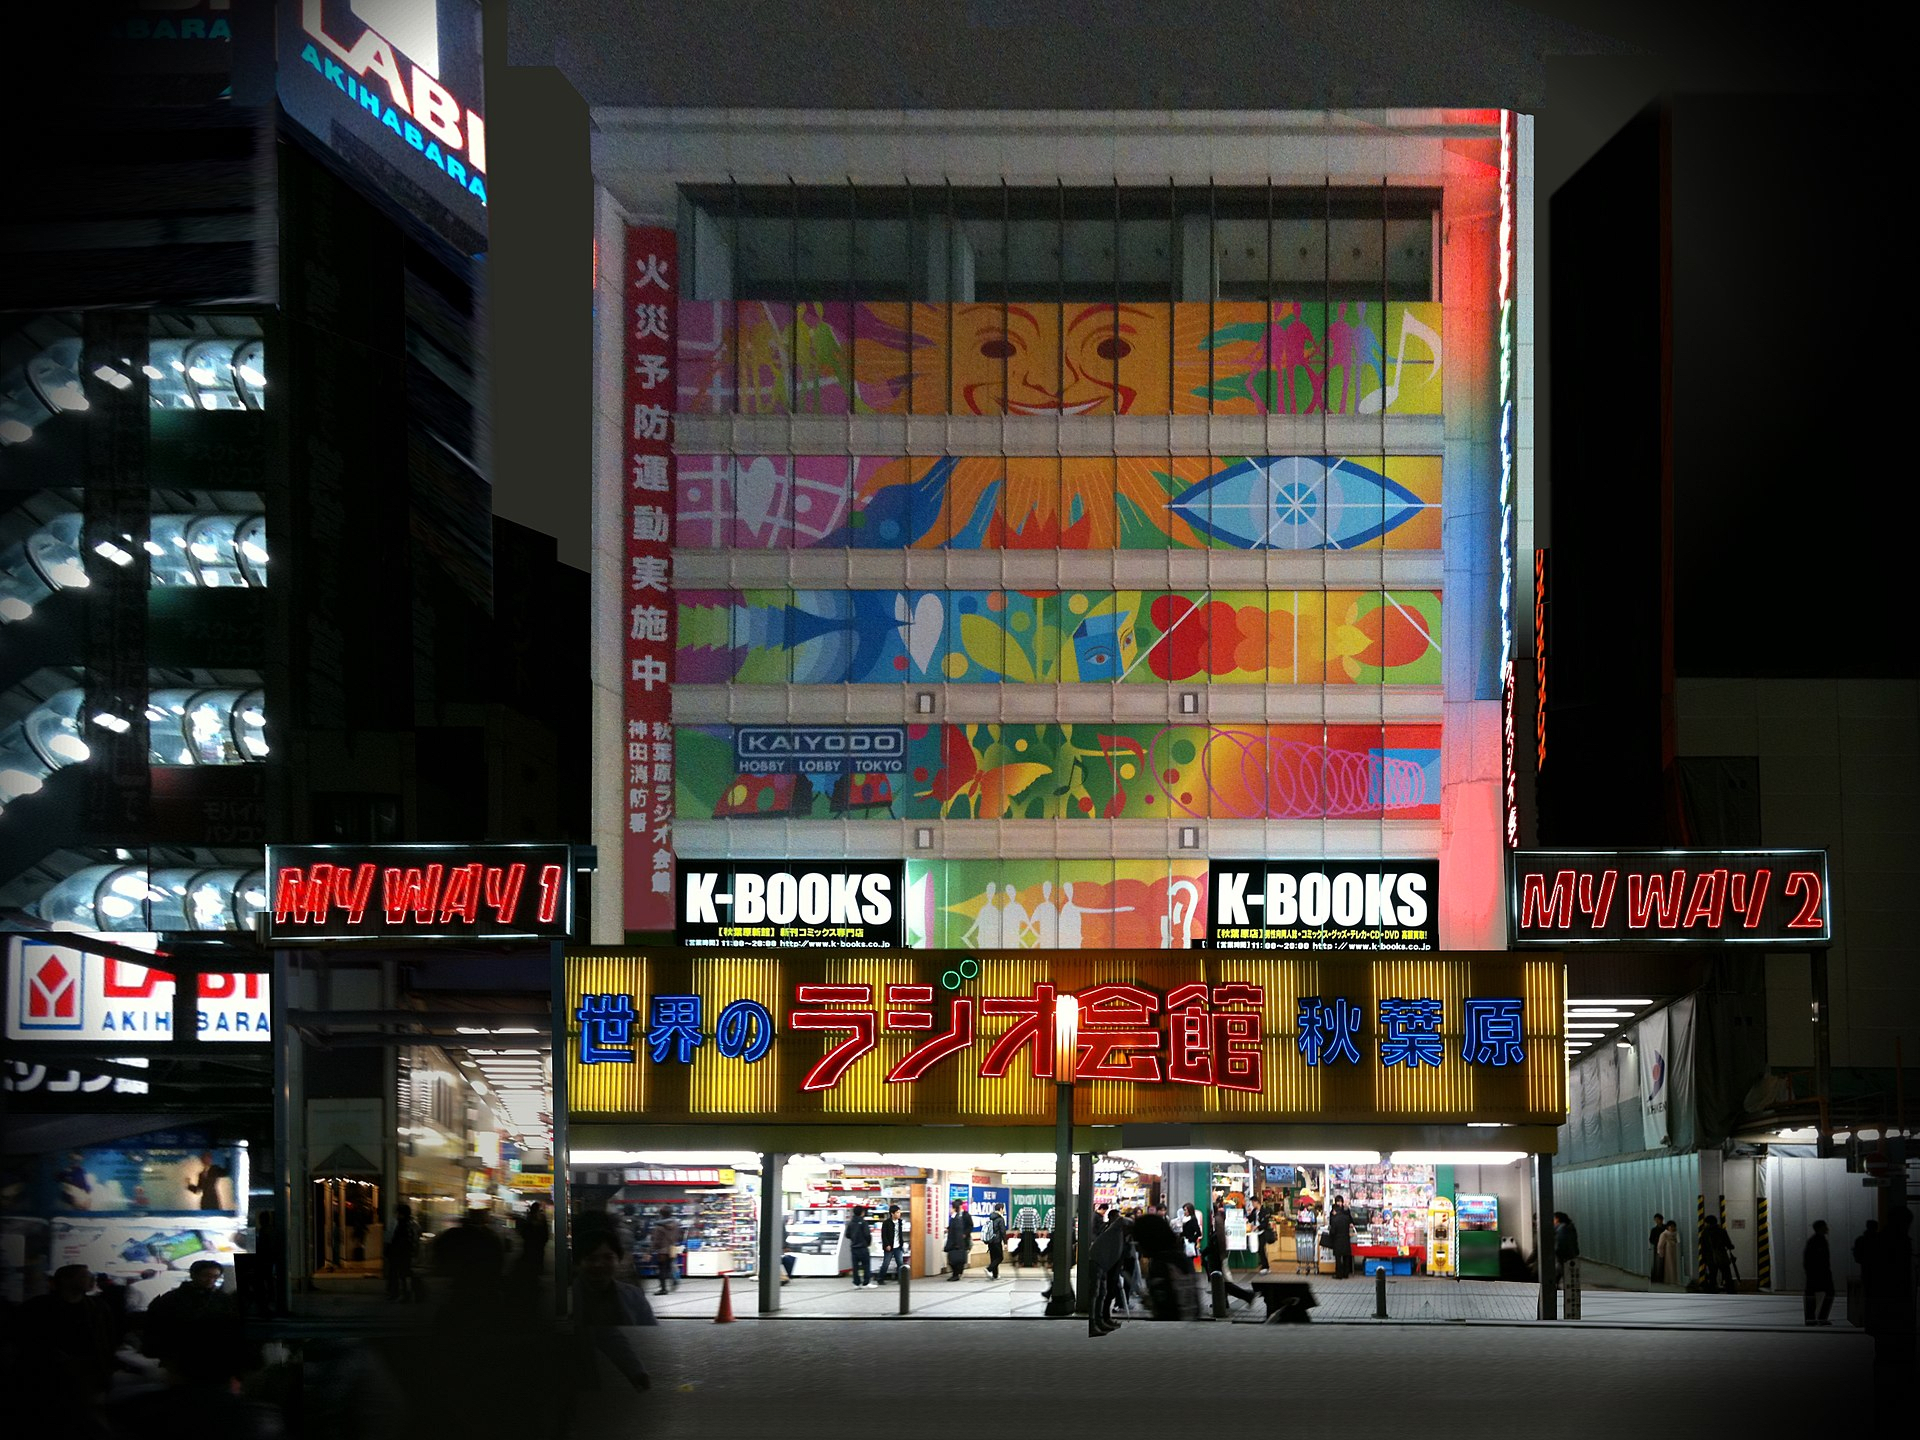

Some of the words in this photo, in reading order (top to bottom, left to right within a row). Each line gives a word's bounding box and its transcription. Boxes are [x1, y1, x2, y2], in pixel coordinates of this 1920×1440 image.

[301, 43, 488, 206] AKIHABARA
[631, 253, 671, 692] 火災予防運動実施中
[739, 760, 785, 772] HOBBY
[799, 760, 842, 772] LOBBY
[855, 760, 903, 772] TOKYO
[749, 735, 895, 751] KAIYODO
[275, 863, 377, 924] MY
[383, 863, 527, 924] WAY
[539, 865, 561, 923] 1
[685, 872, 893, 925] K-BOOKS
[1217, 872, 1428, 927] K-BOOKS
[1520, 870, 1618, 928] MY
[1628, 869, 1771, 928] WAY
[1784, 872, 1824, 928] 2
[101, 1010, 270, 1032] AKIHBARA
[576, 993, 774, 1065] 世界の
[791, 959, 1264, 1094] ラジオ会館
[1297, 997, 1527, 1068] 秋葉原
[860, 1166, 906, 1177] TOSHIBA
